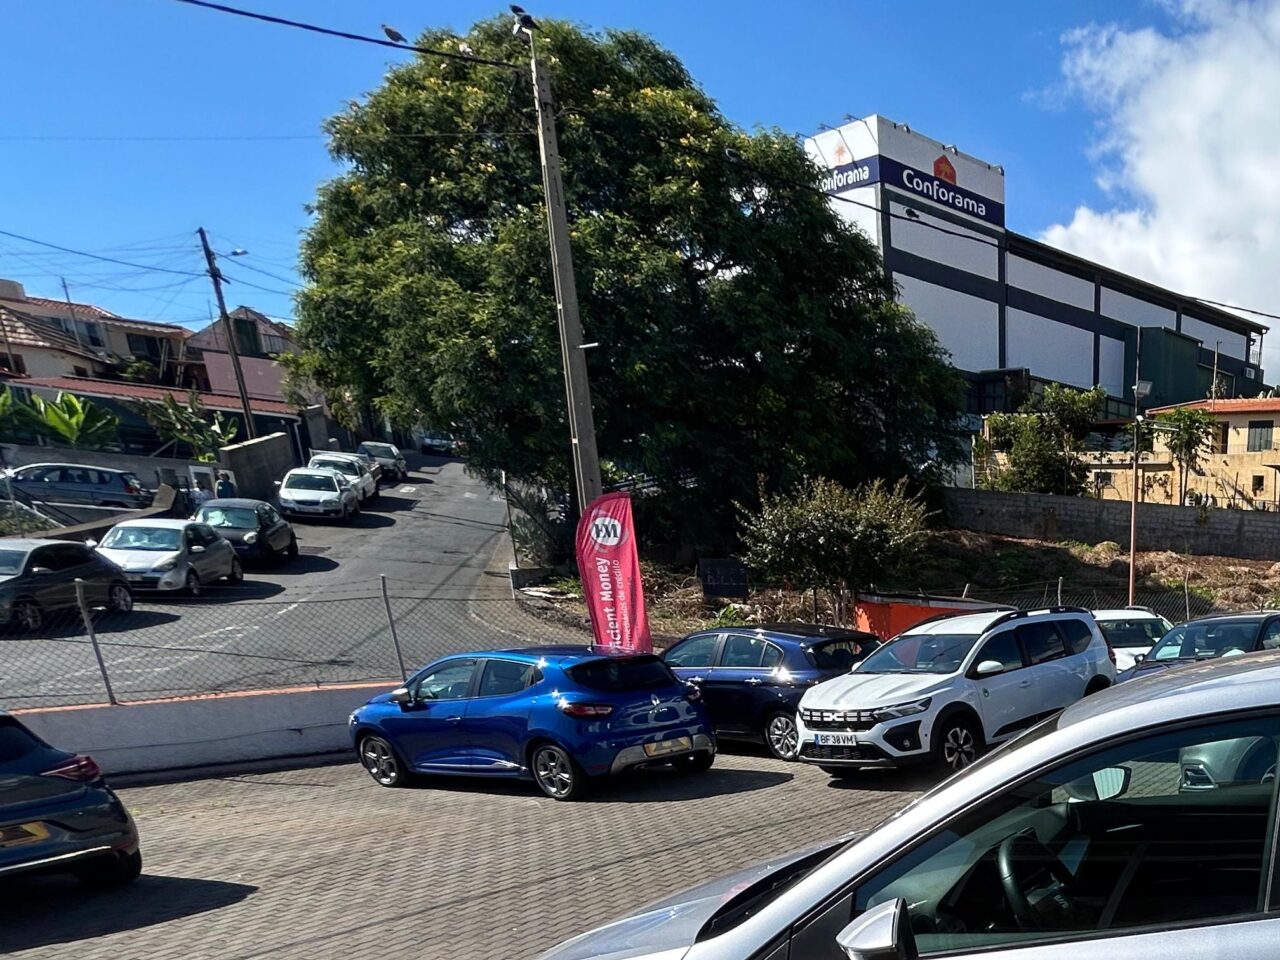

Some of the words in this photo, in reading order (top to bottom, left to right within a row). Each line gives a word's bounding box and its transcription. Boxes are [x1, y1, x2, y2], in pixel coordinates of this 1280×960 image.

[816, 165, 870, 192] onforama
[902, 169, 986, 216] Conforama
[595, 557, 614, 602] Money
